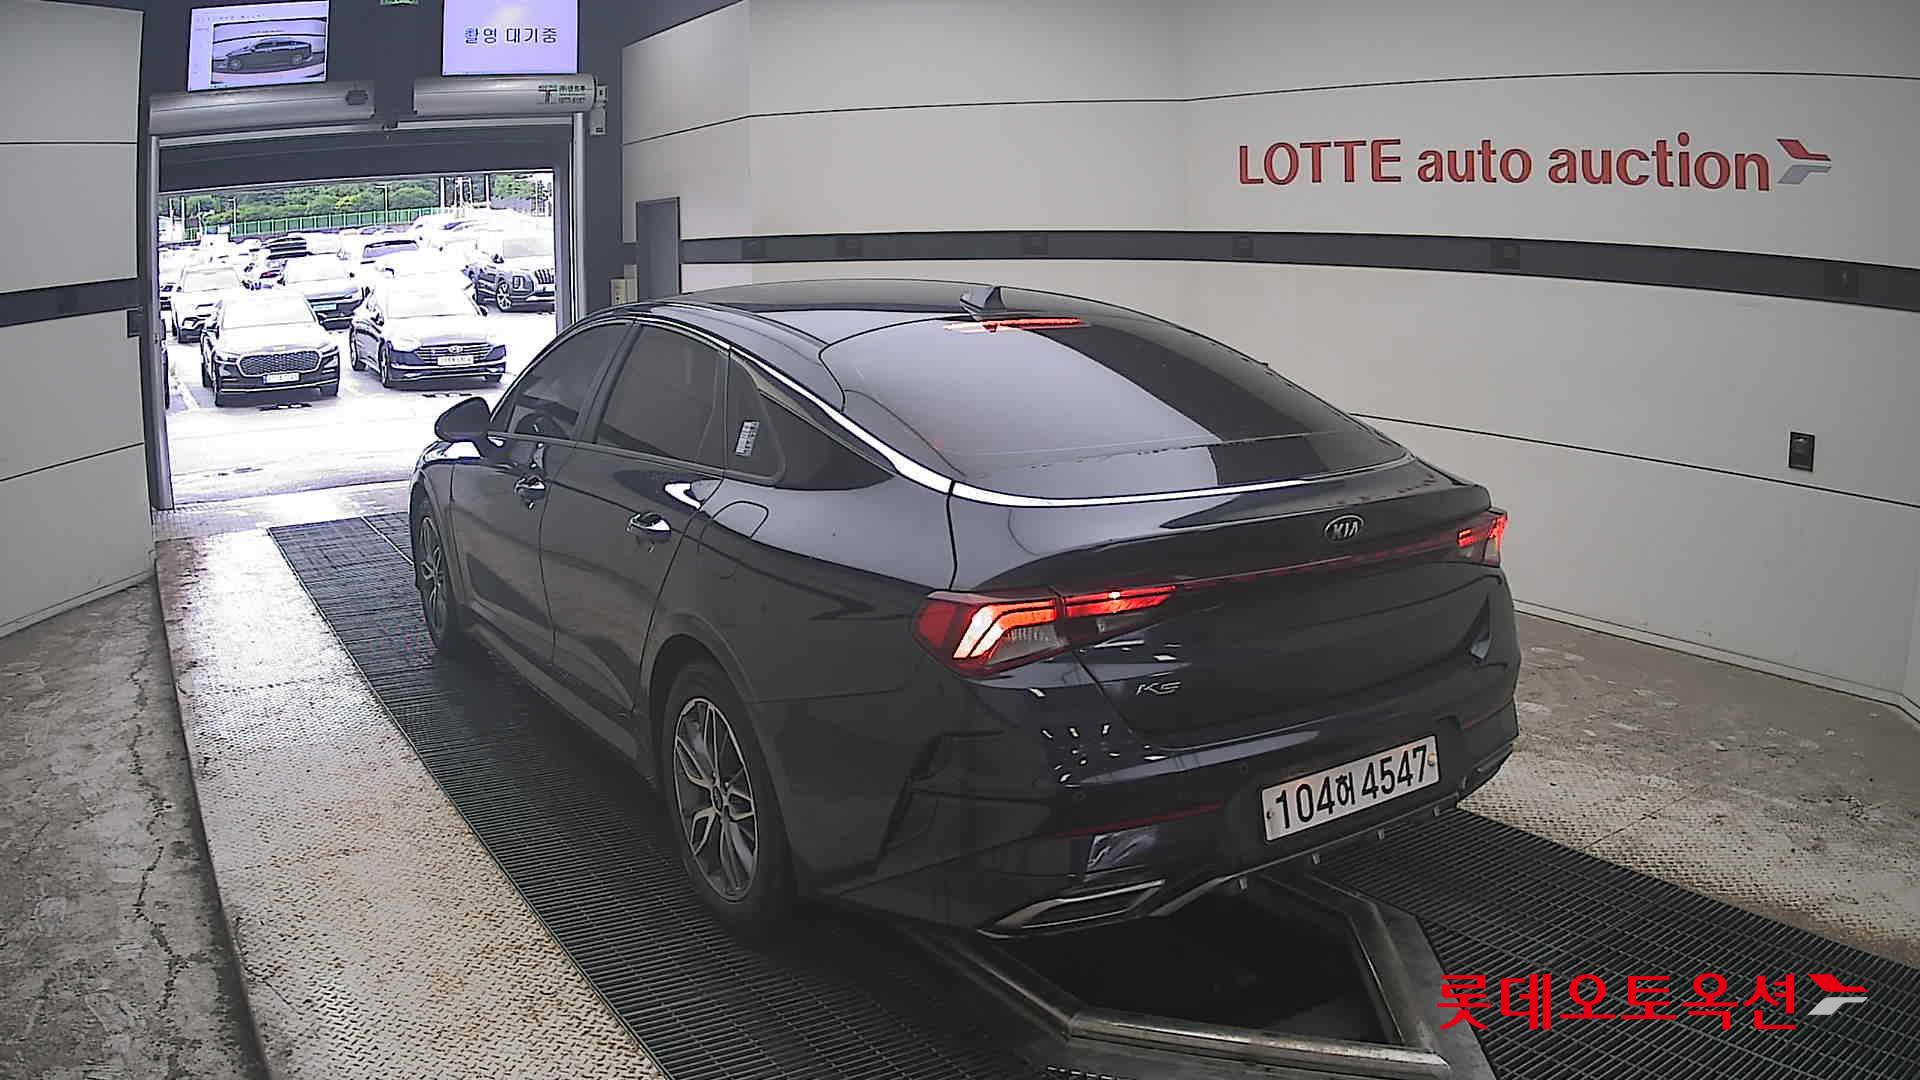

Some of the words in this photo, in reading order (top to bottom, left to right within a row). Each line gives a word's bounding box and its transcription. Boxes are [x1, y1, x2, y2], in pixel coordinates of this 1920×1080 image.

[506, 27, 558, 44] 대기중
[1239, 138, 1401, 186] LOTTE
[1416, 138, 1533, 184] auto
[1547, 132, 1771, 192] auction
[1331, 520, 1359, 540] KIA
[1135, 681, 1181, 695] K5
[1361, 744, 1428, 799] 4547
